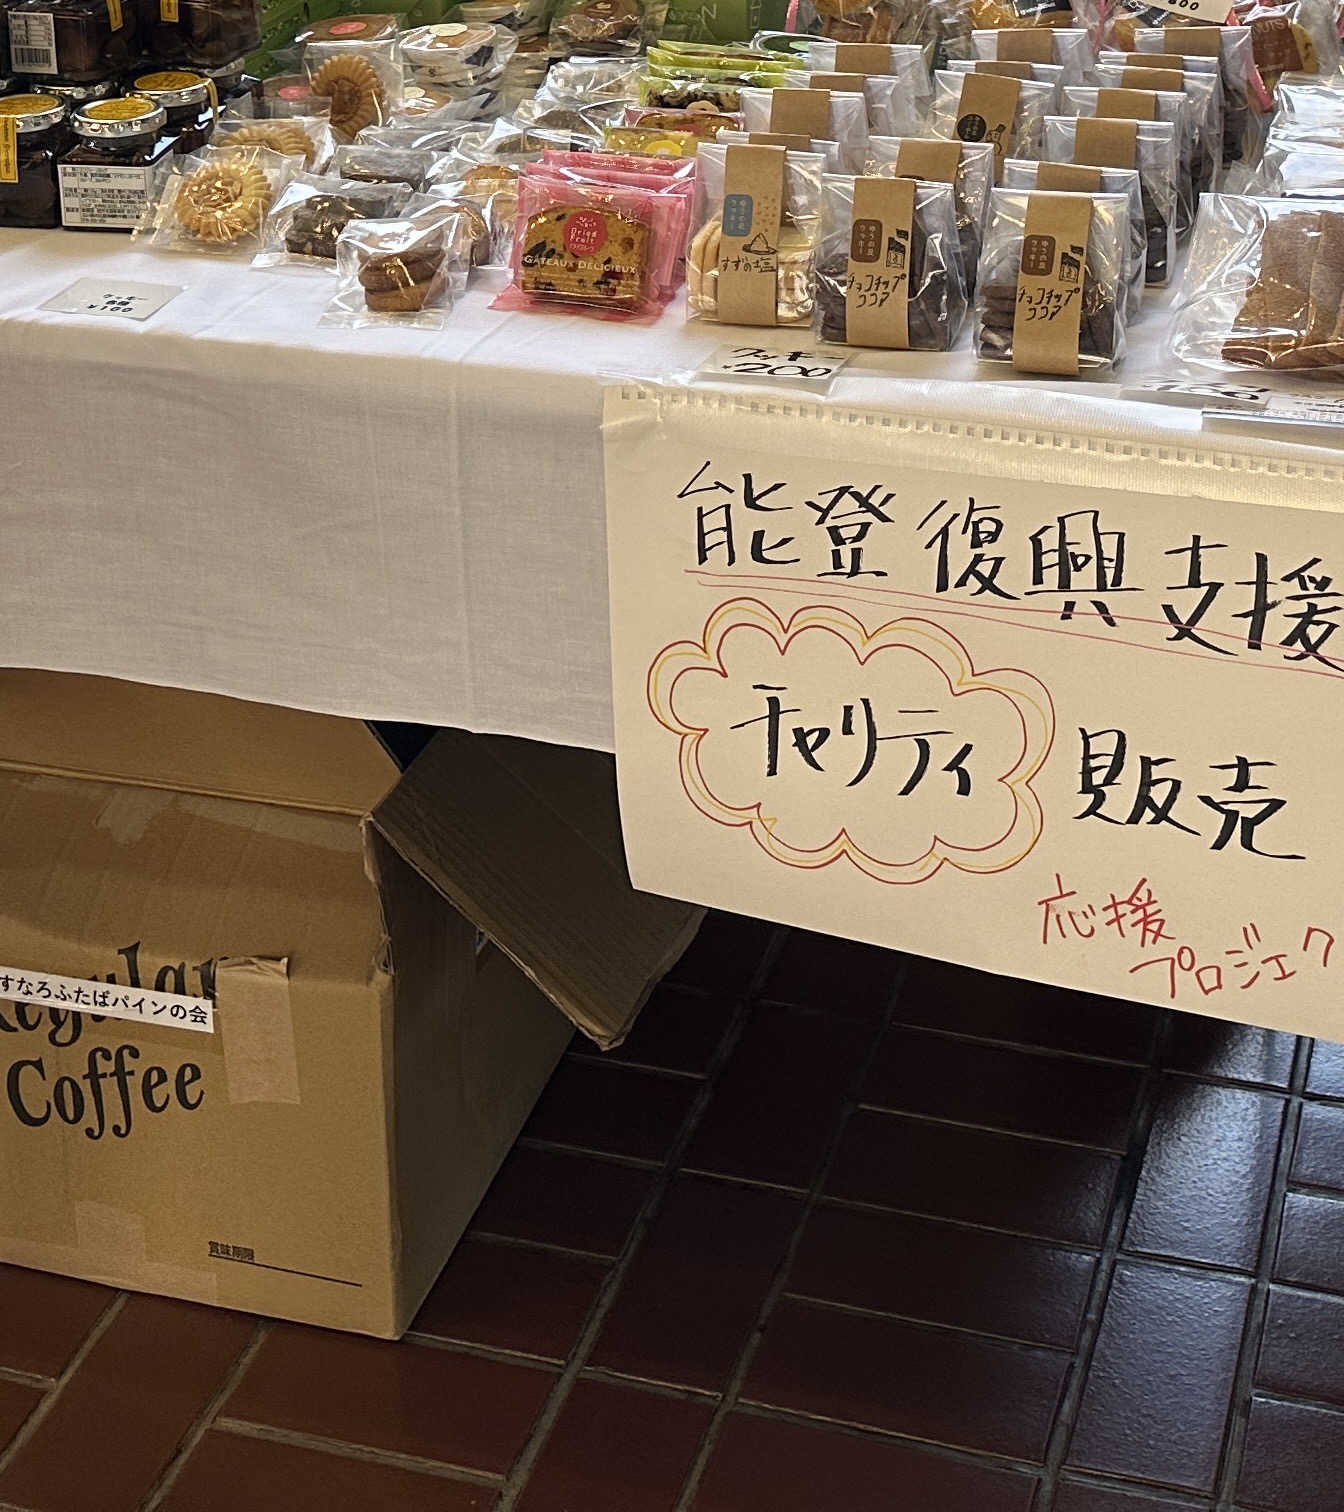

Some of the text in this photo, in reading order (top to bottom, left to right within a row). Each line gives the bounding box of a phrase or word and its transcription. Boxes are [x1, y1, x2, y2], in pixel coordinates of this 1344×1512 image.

[729, 684, 1307, 862] チャリティ 販売
[1038, 874, 1179, 948] 応援
[6, 1043, 205, 1141] Coffee
